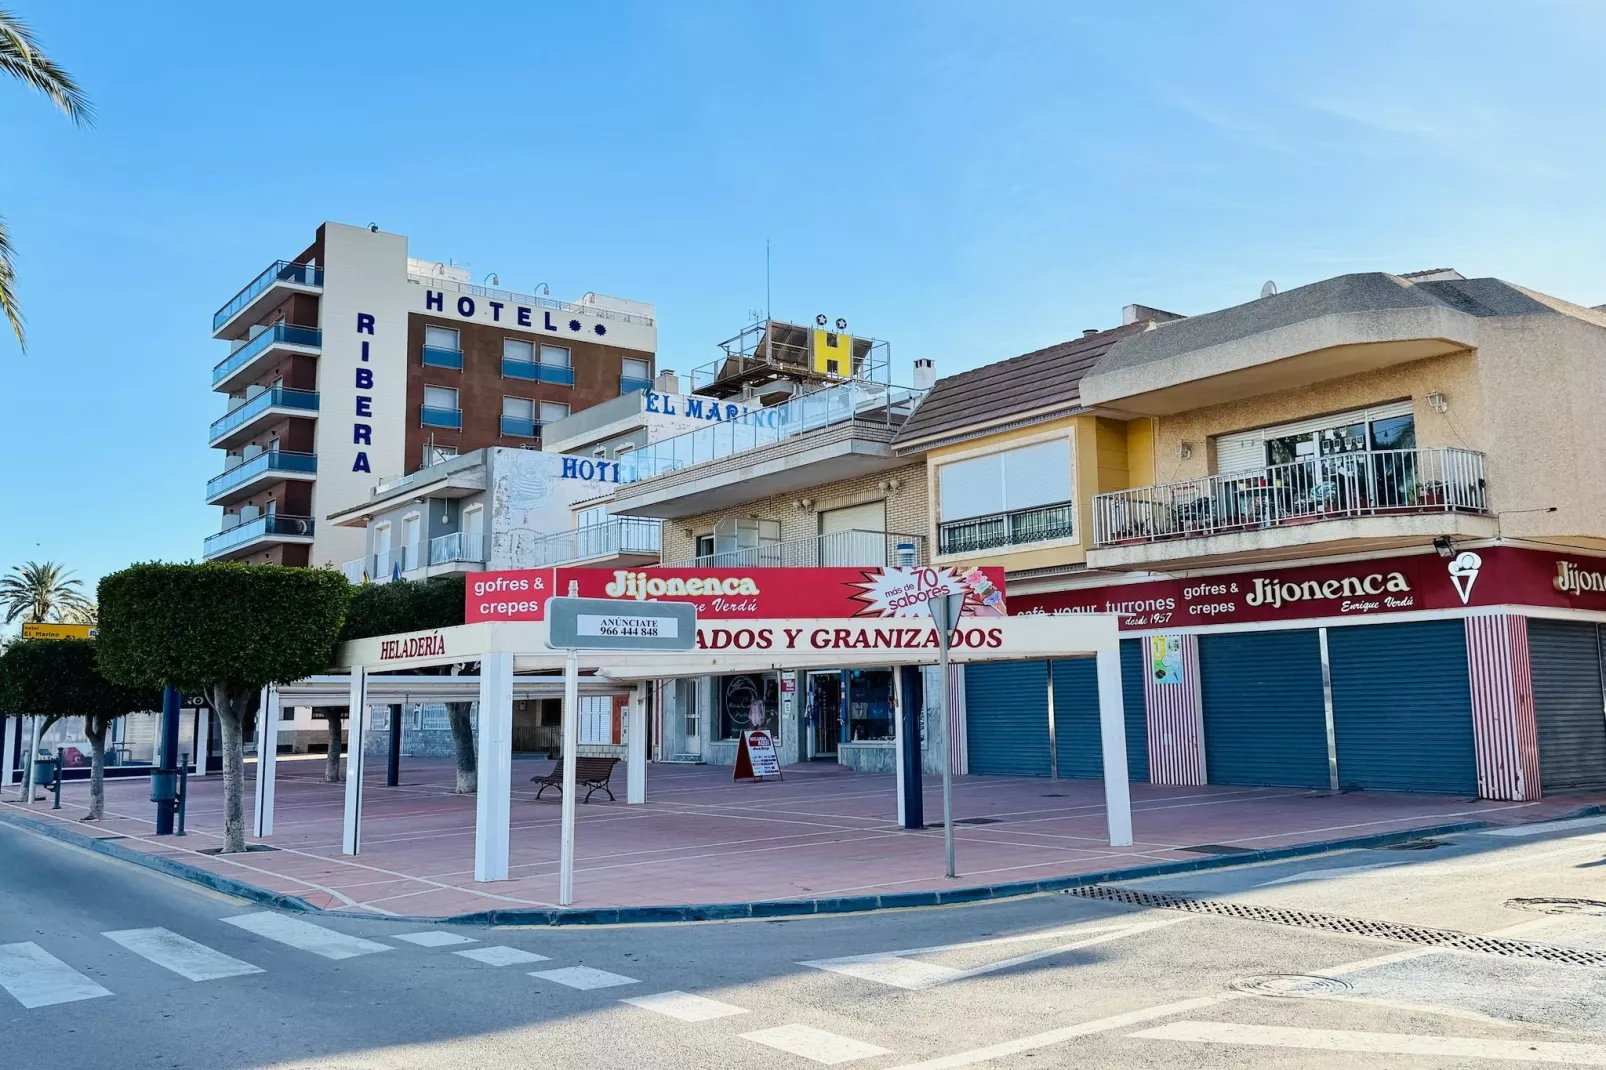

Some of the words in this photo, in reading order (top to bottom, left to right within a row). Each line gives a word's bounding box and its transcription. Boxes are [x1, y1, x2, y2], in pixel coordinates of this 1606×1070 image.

[426, 290, 557, 332] HOTEL
[813, 328, 853, 379] H
[352, 312, 376, 474] RIBERA
[645, 391, 676, 416] EL
[474, 577, 529, 596] gofres
[533, 577, 544, 590] &
[605, 570, 760, 602] Jijonenca
[885, 587, 903, 598] más
[903, 583, 915, 592] de
[910, 568, 939, 592] 70
[1552, 560, 1606, 596] Jijon
[888, 584, 951, 611] sabores
[1183, 583, 1227, 600] gofres
[1229, 582, 1239, 593] &
[1245, 571, 1412, 609] Jijonenca
[479, 600, 539, 616] crepes
[711, 597, 758, 613] Verdú
[1105, 597, 1176, 614] turrones
[1188, 602, 1236, 616] crepes
[1340, 600, 1380, 613] Enrique
[1384, 596, 1414, 608] Verdú
[600, 617, 659, 628] ANÚNCIATE
[1124, 615, 1148, 626] desde
[1150, 612, 1173, 625] 1957
[600, 626, 618, 636] 966
[620, 627, 638, 636] 444
[640, 627, 659, 637] 848
[783, 629, 803, 649] Y
[810, 628, 1003, 649] GRANIZADOS
[380, 630, 446, 660] HELADERÍA
